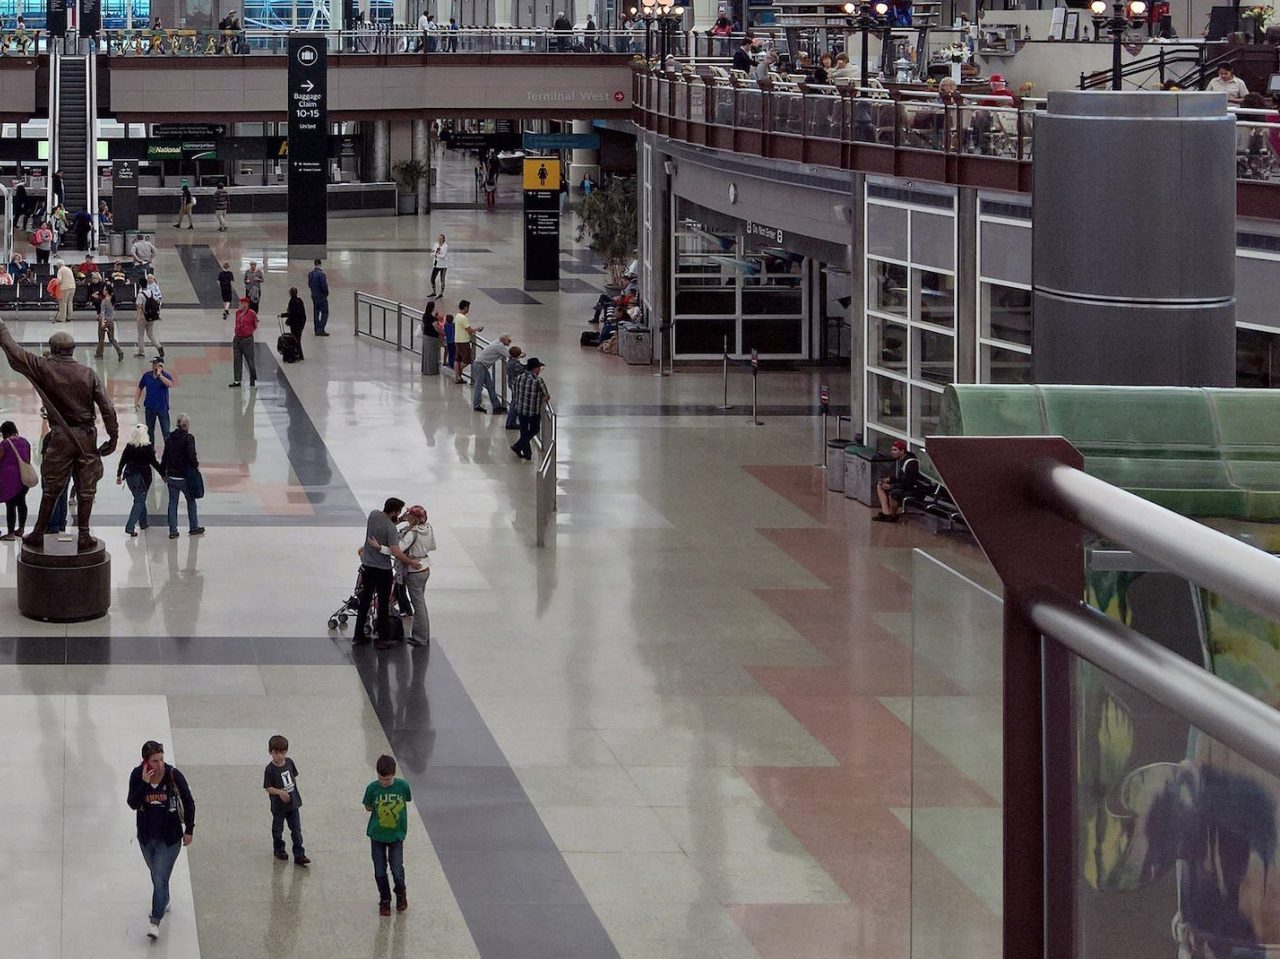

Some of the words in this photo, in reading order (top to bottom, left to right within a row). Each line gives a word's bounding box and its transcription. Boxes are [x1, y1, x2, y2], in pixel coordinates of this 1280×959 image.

[527, 92, 575, 101] Terminal
[580, 92, 610, 101] West
[296, 109, 320, 118] 10-15
[766, 228, 776, 239] Enter
